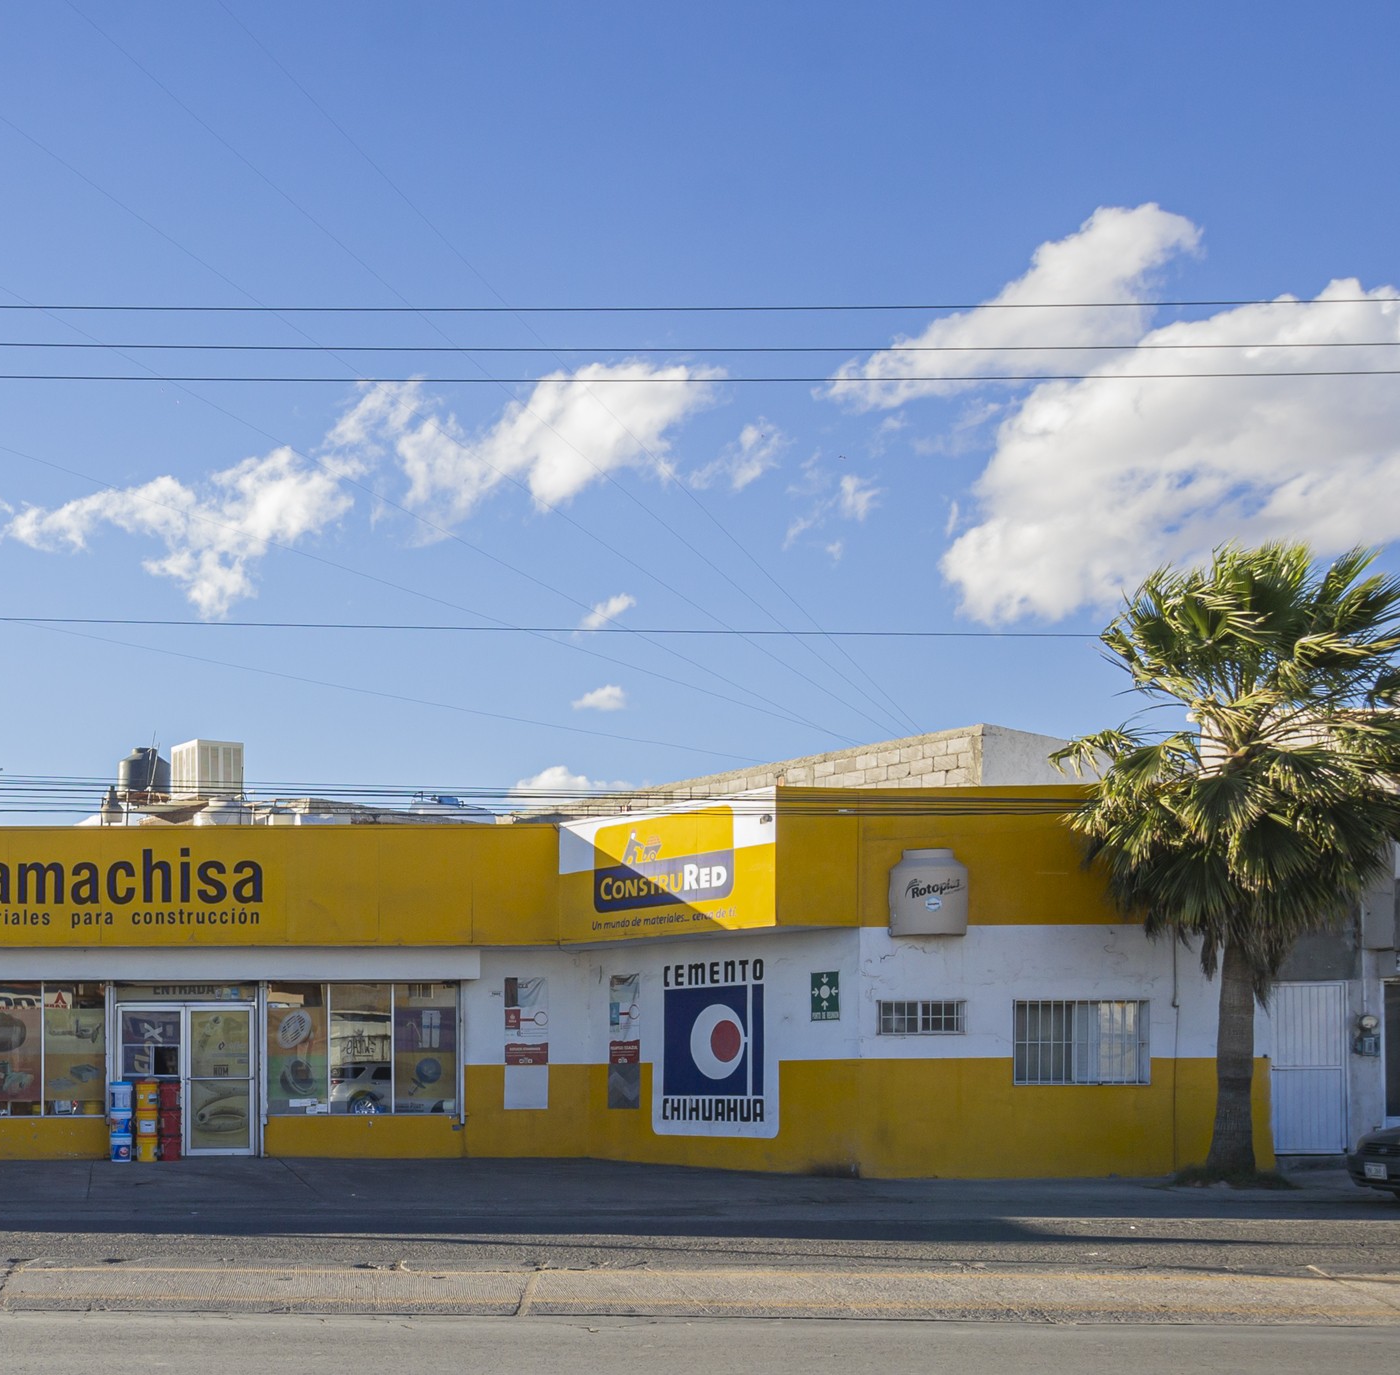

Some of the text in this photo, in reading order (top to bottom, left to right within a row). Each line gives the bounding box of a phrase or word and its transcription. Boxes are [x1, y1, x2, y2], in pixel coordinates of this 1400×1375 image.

[71, 911, 114, 928] para
[131, 908, 260, 925] construcción
[592, 920, 602, 930] Un
[604, 917, 630, 929] mundo
[631, 915, 642, 927] de
[692, 911, 713, 921] cerca
[716, 908, 726, 919] de
[663, 958, 764, 987] CEMENTO
[662, 1098, 765, 1122] CHIHUAHUA
